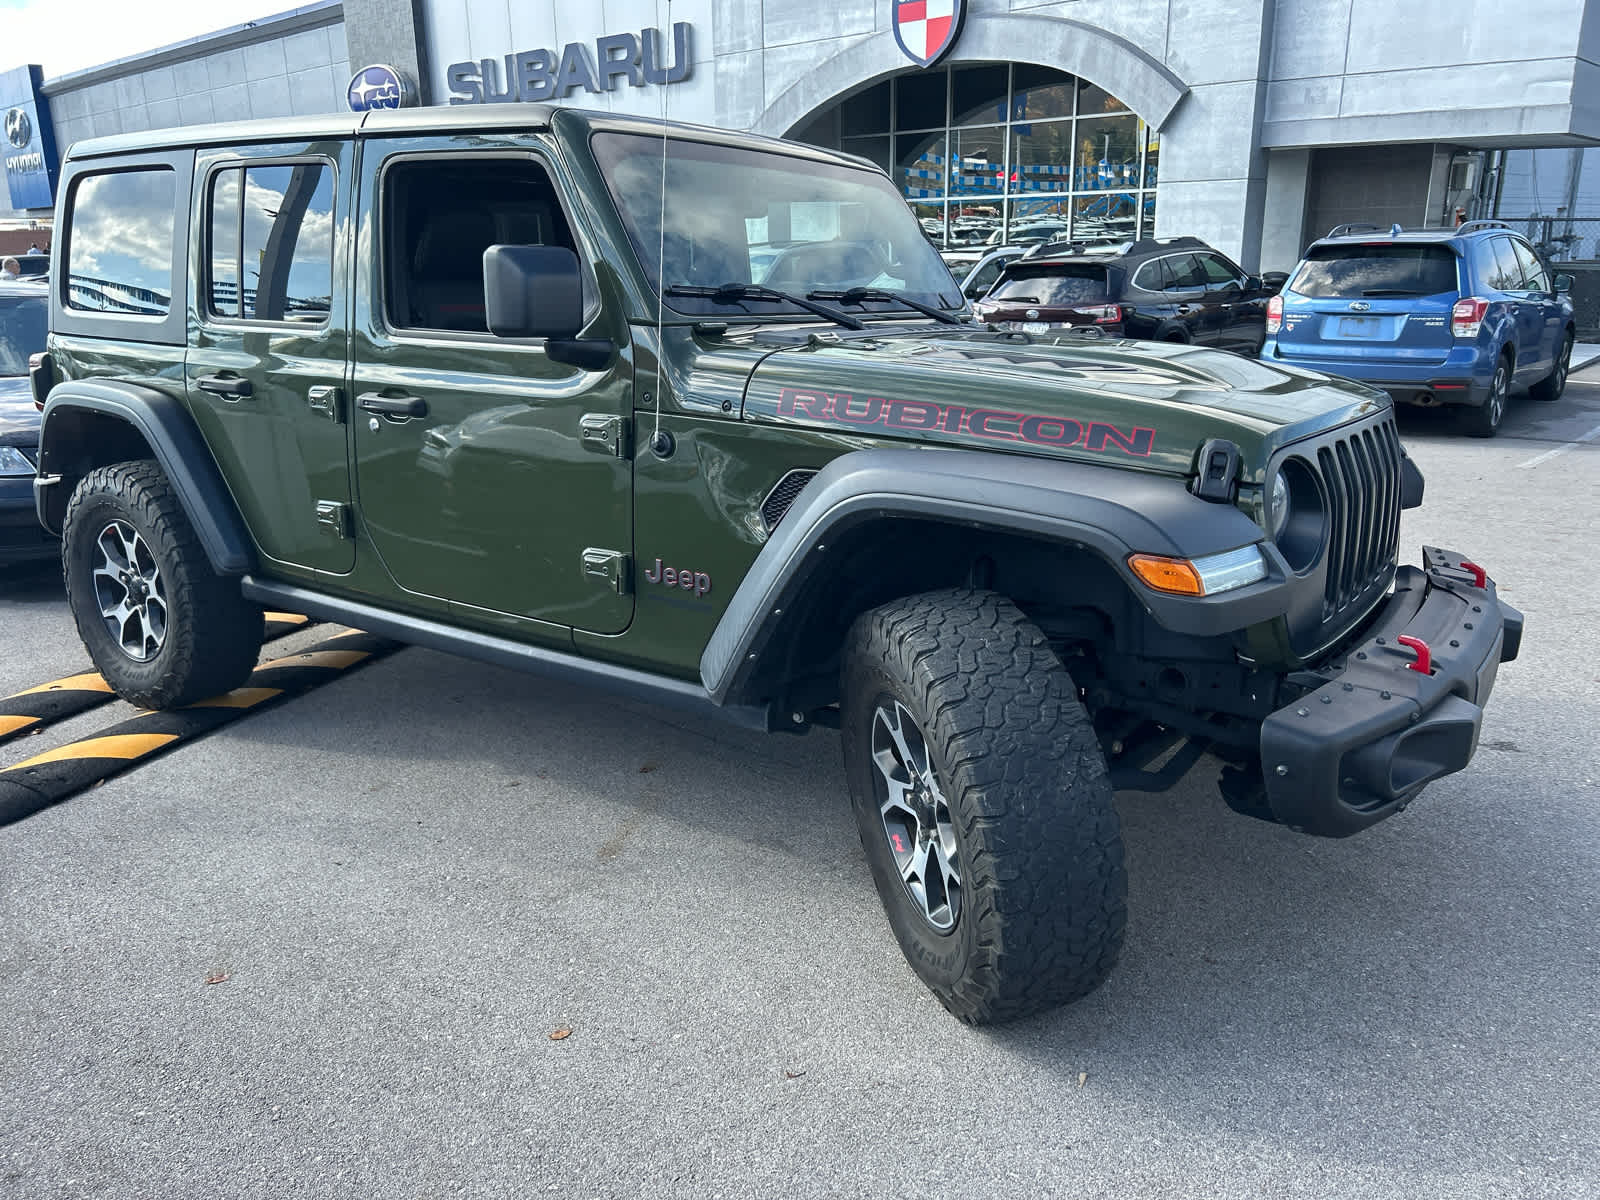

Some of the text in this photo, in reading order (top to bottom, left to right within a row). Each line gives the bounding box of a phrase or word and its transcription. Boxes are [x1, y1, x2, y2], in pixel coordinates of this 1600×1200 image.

[446, 21, 692, 106] SUBARU
[776, 387, 1156, 458] RUBICON
[644, 558, 712, 598] Jeep
